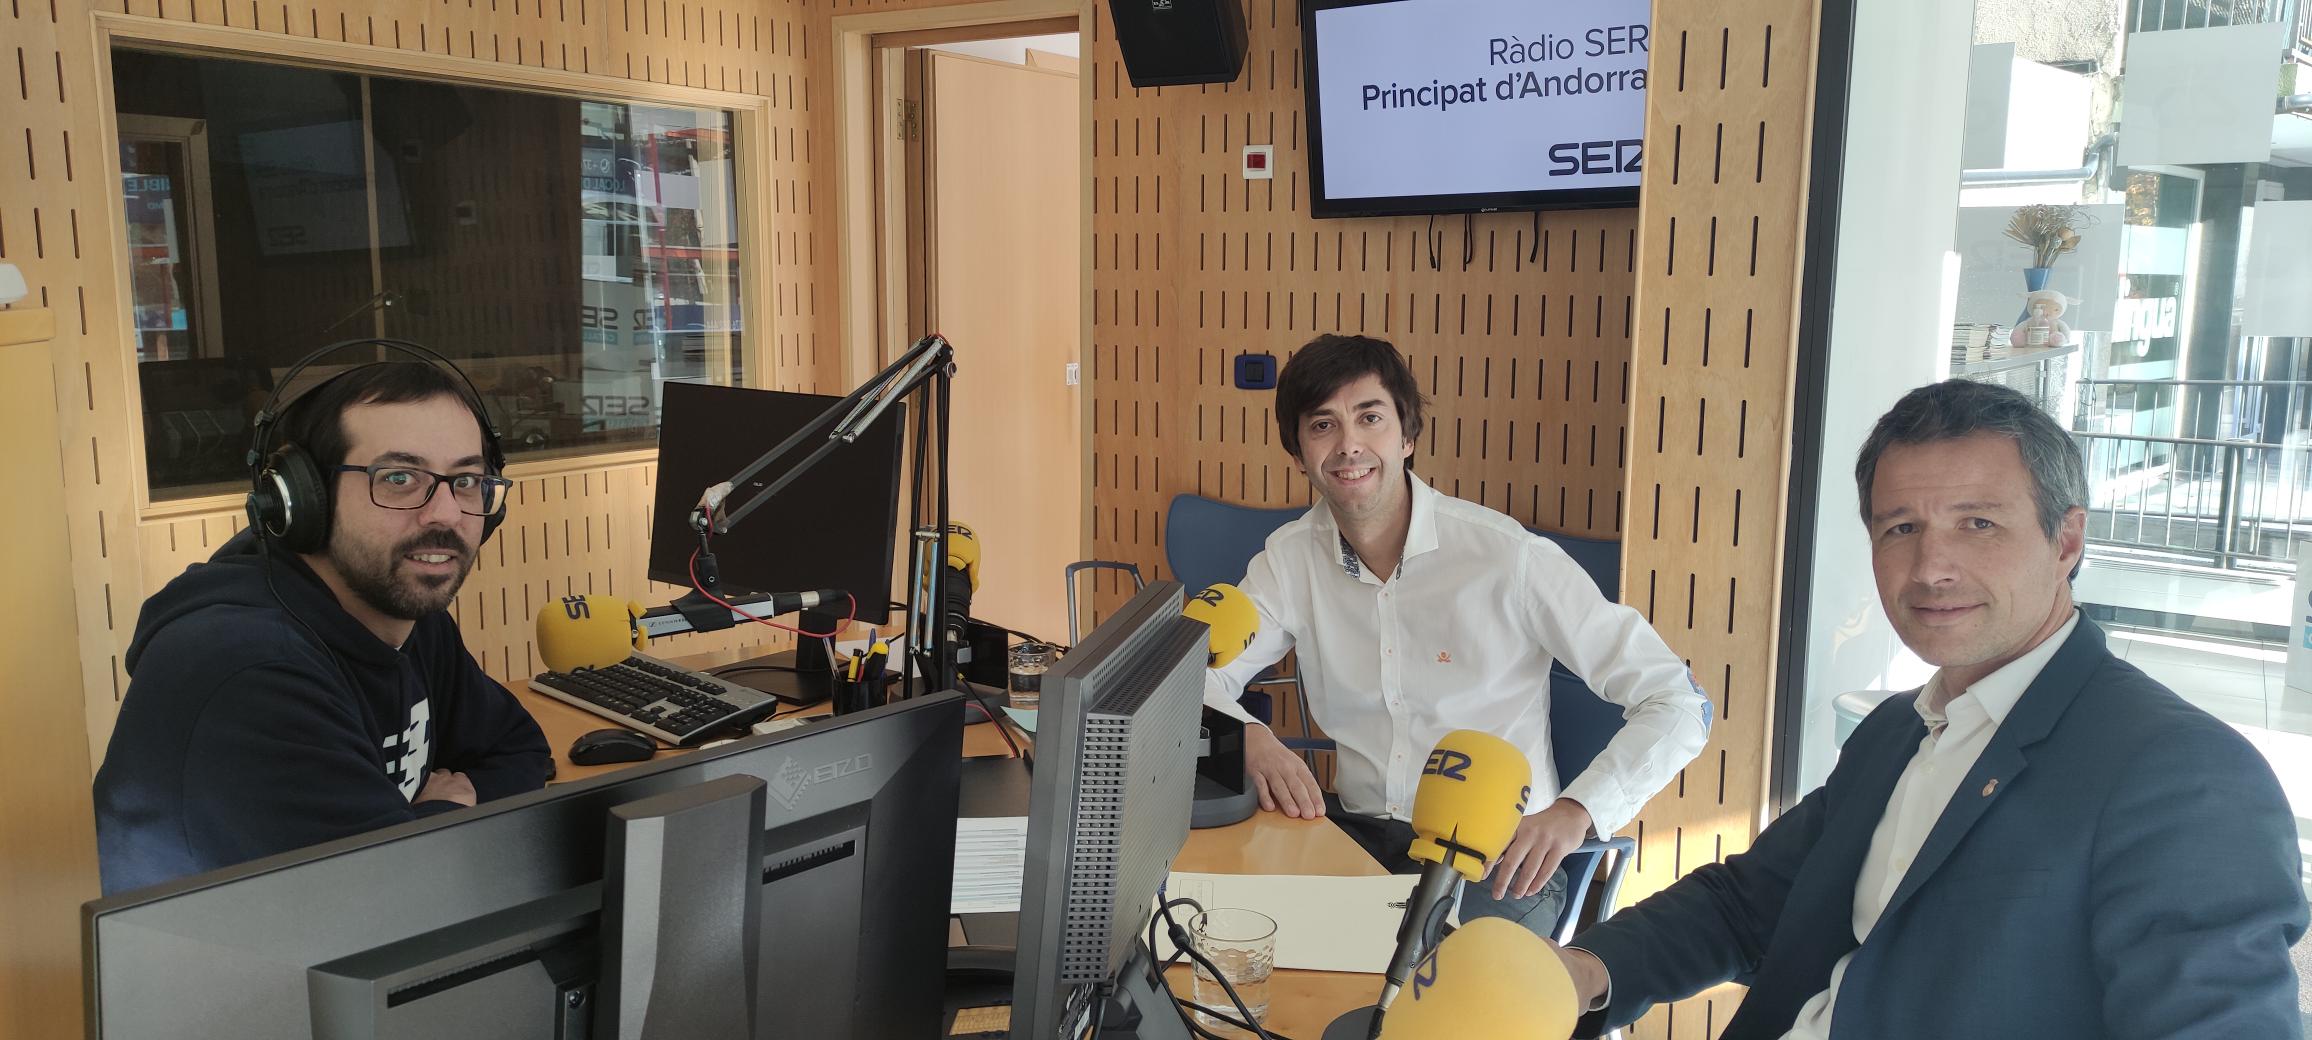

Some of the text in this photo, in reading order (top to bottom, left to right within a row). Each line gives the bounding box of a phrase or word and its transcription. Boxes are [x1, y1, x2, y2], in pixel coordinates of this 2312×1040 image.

[1489, 24, 1648, 66] Ràdio SER
[1362, 77, 1488, 112] Principat
[1548, 138, 1644, 177] SER
[947, 524, 973, 540] ER
[813, 753, 873, 785] EIZO
[1422, 749, 1472, 782] ER
